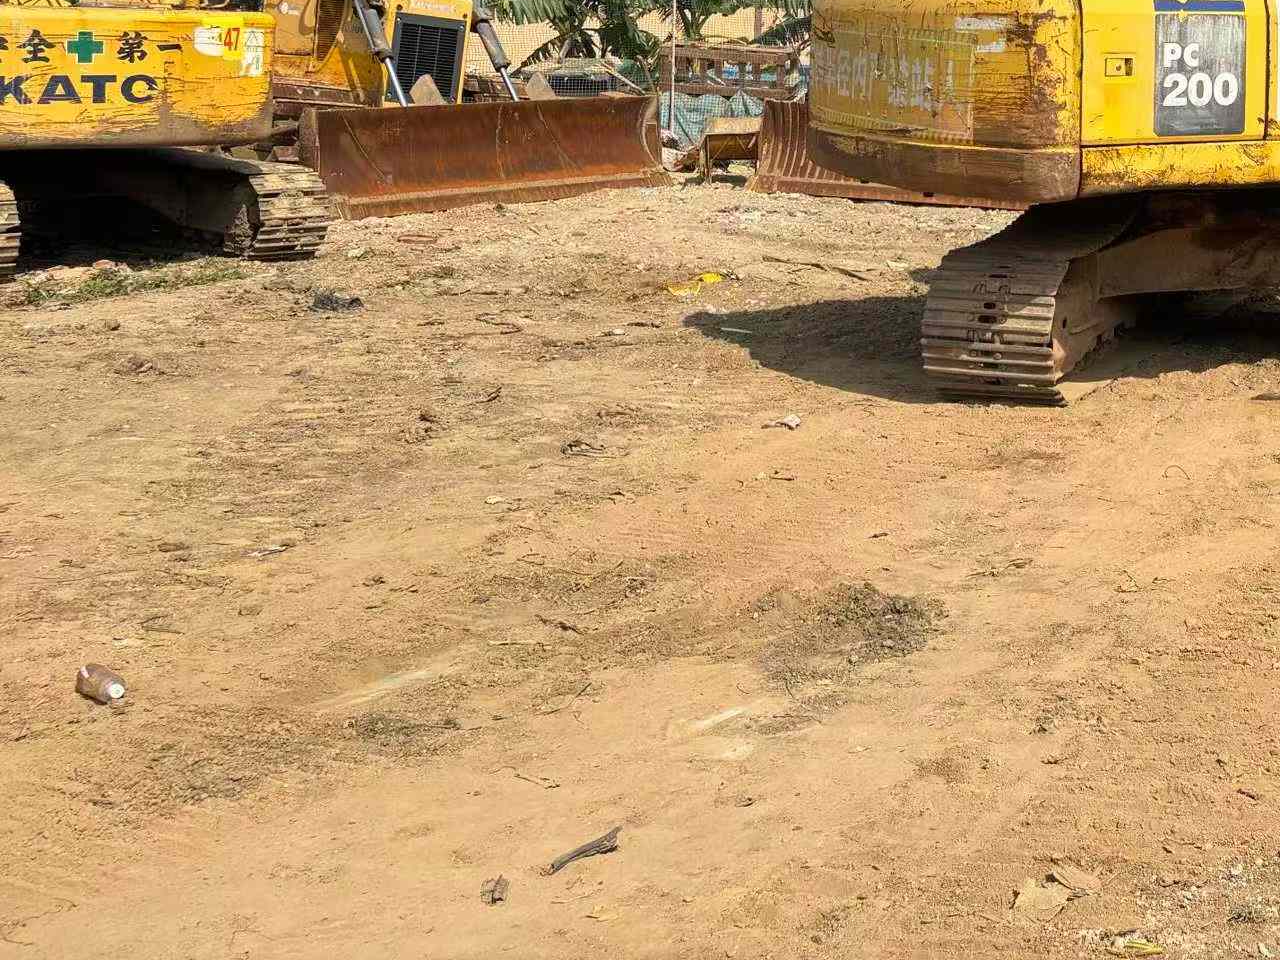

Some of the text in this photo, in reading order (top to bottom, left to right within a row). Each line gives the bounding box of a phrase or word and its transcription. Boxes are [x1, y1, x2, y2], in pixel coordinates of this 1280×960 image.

[116, 31, 183, 64] 第一
[1163, 43, 1200, 68] PC
[1162, 73, 1239, 107] 200
